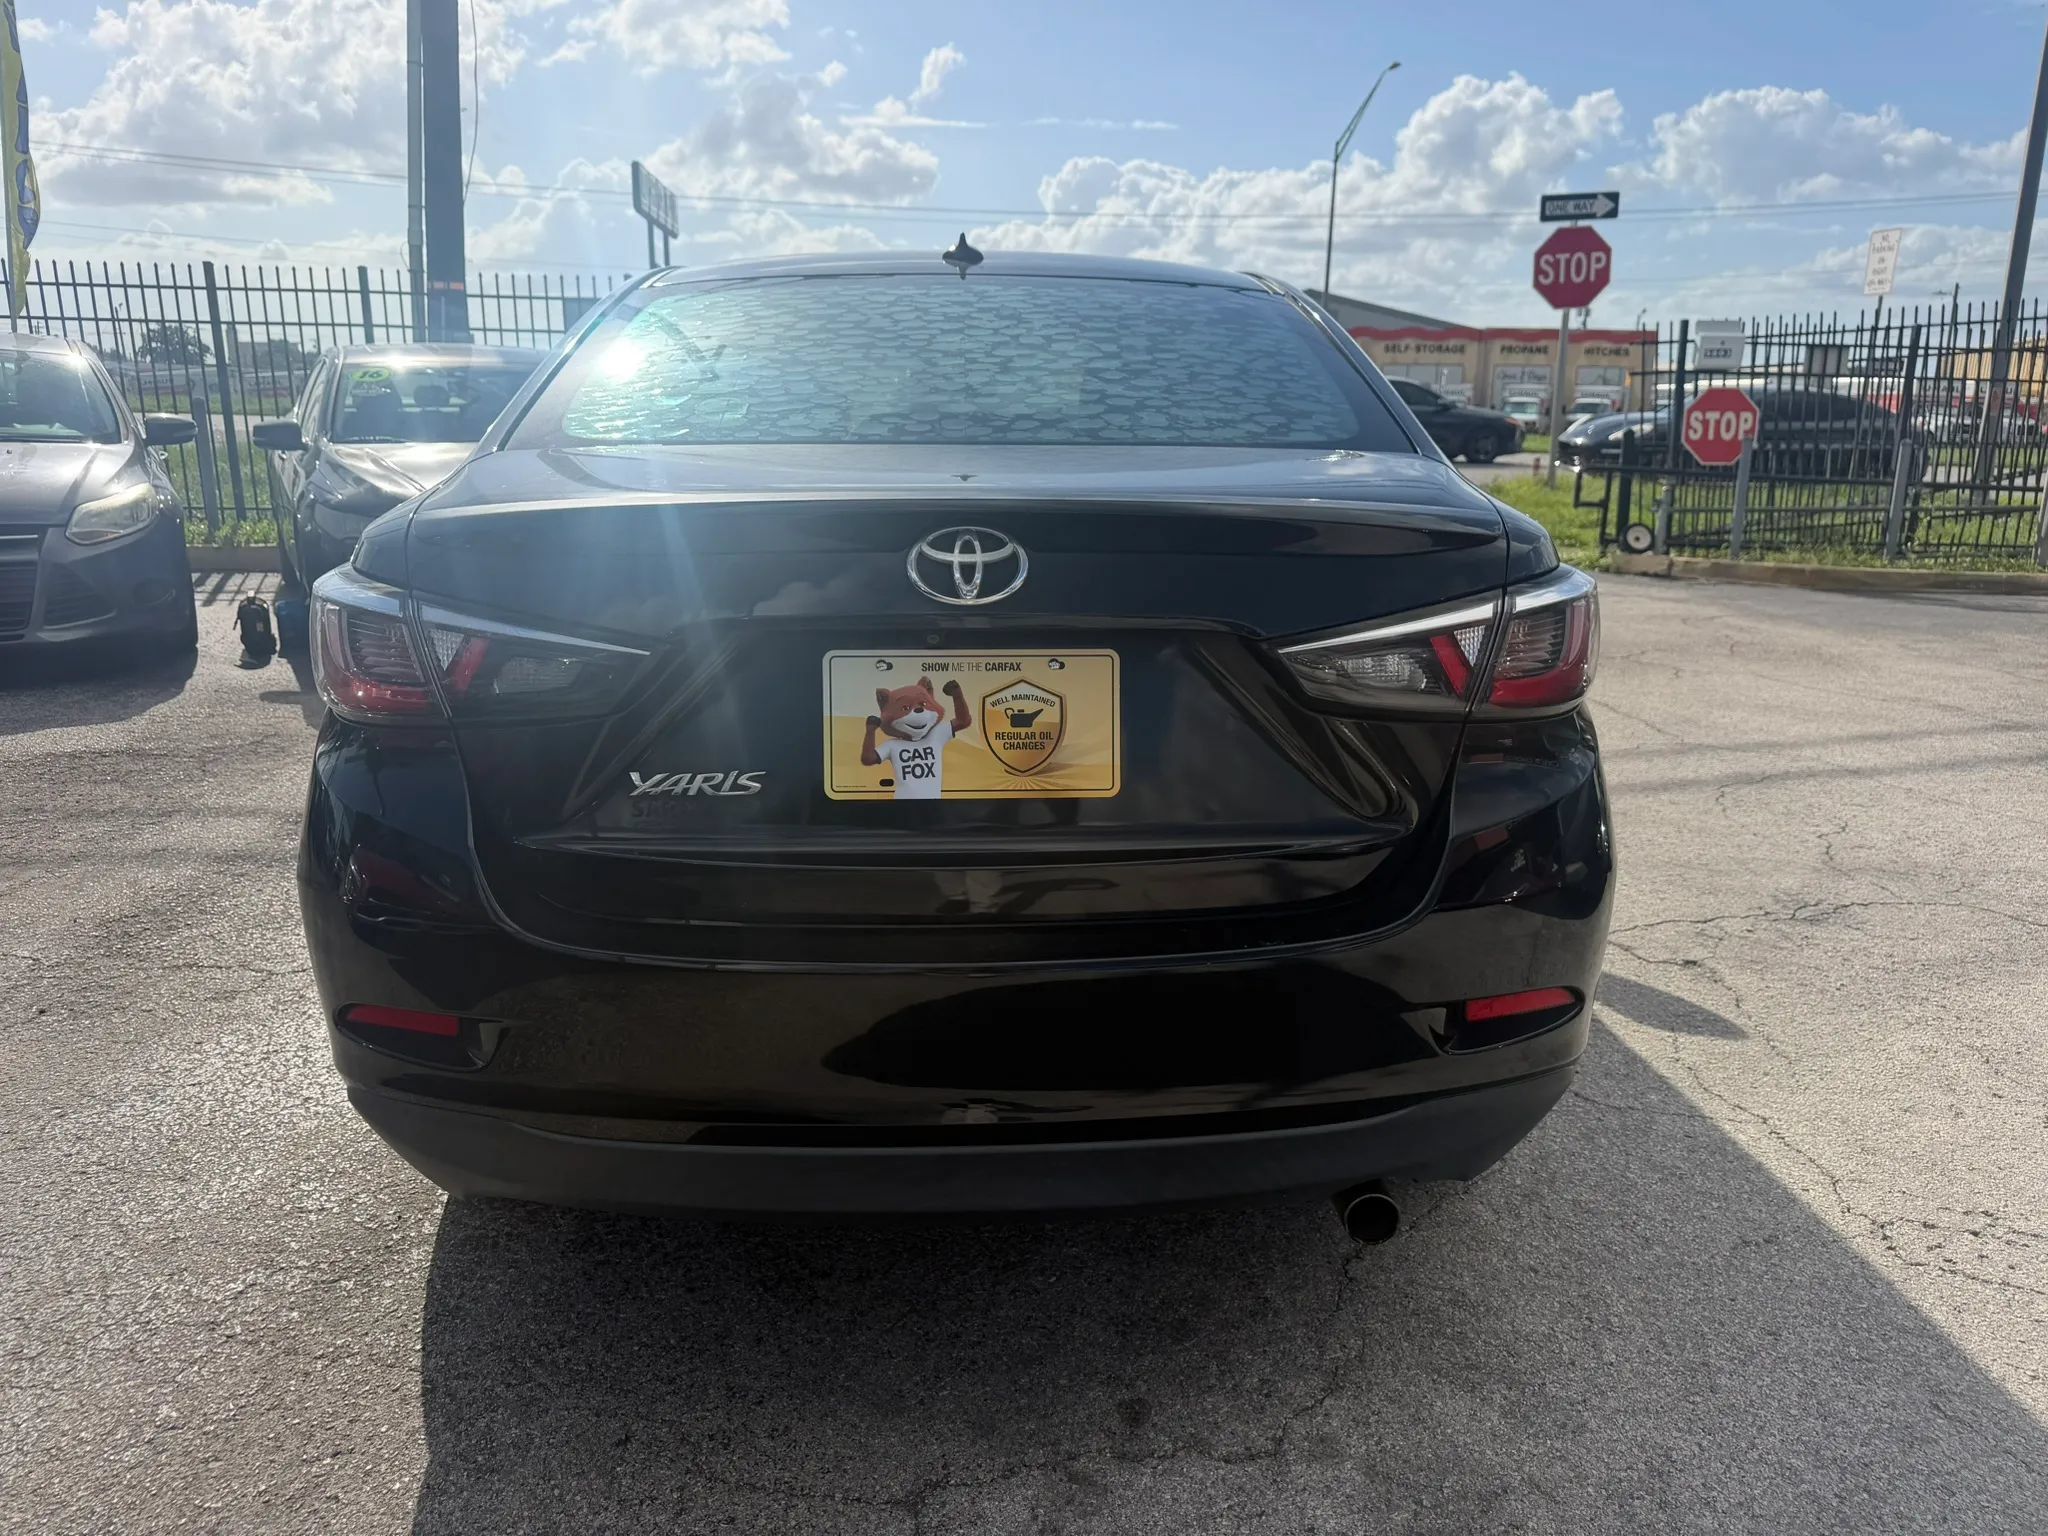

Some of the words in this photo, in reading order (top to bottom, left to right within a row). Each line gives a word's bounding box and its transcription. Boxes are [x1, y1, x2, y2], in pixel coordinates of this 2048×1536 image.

[1549, 200, 1569, 213] ONE
[1572, 199, 1593, 211] WAY
[1538, 251, 1607, 286] STOP
[1383, 343, 1466, 355] SELF-STORAGE
[1500, 344, 1549, 356] PROPANE
[1583, 346, 1630, 357] HITCHES
[1688, 410, 1754, 441] STOP
[921, 662, 949, 671] SHOW
[952, 662, 965, 671] ME
[967, 662, 983, 671] THE
[985, 662, 1021, 671] CARFAX
[990, 696, 1010, 708] WELL
[1011, 694, 1056, 708] MAINTAINED
[995, 732, 1036, 741] REGULAR
[1039, 732, 1054, 741] OIL
[1003, 741, 1045, 750] CHANGES
[899, 747, 936, 763] CAR
[902, 763, 936, 780] FOX
[629, 770, 767, 796] YARIS
